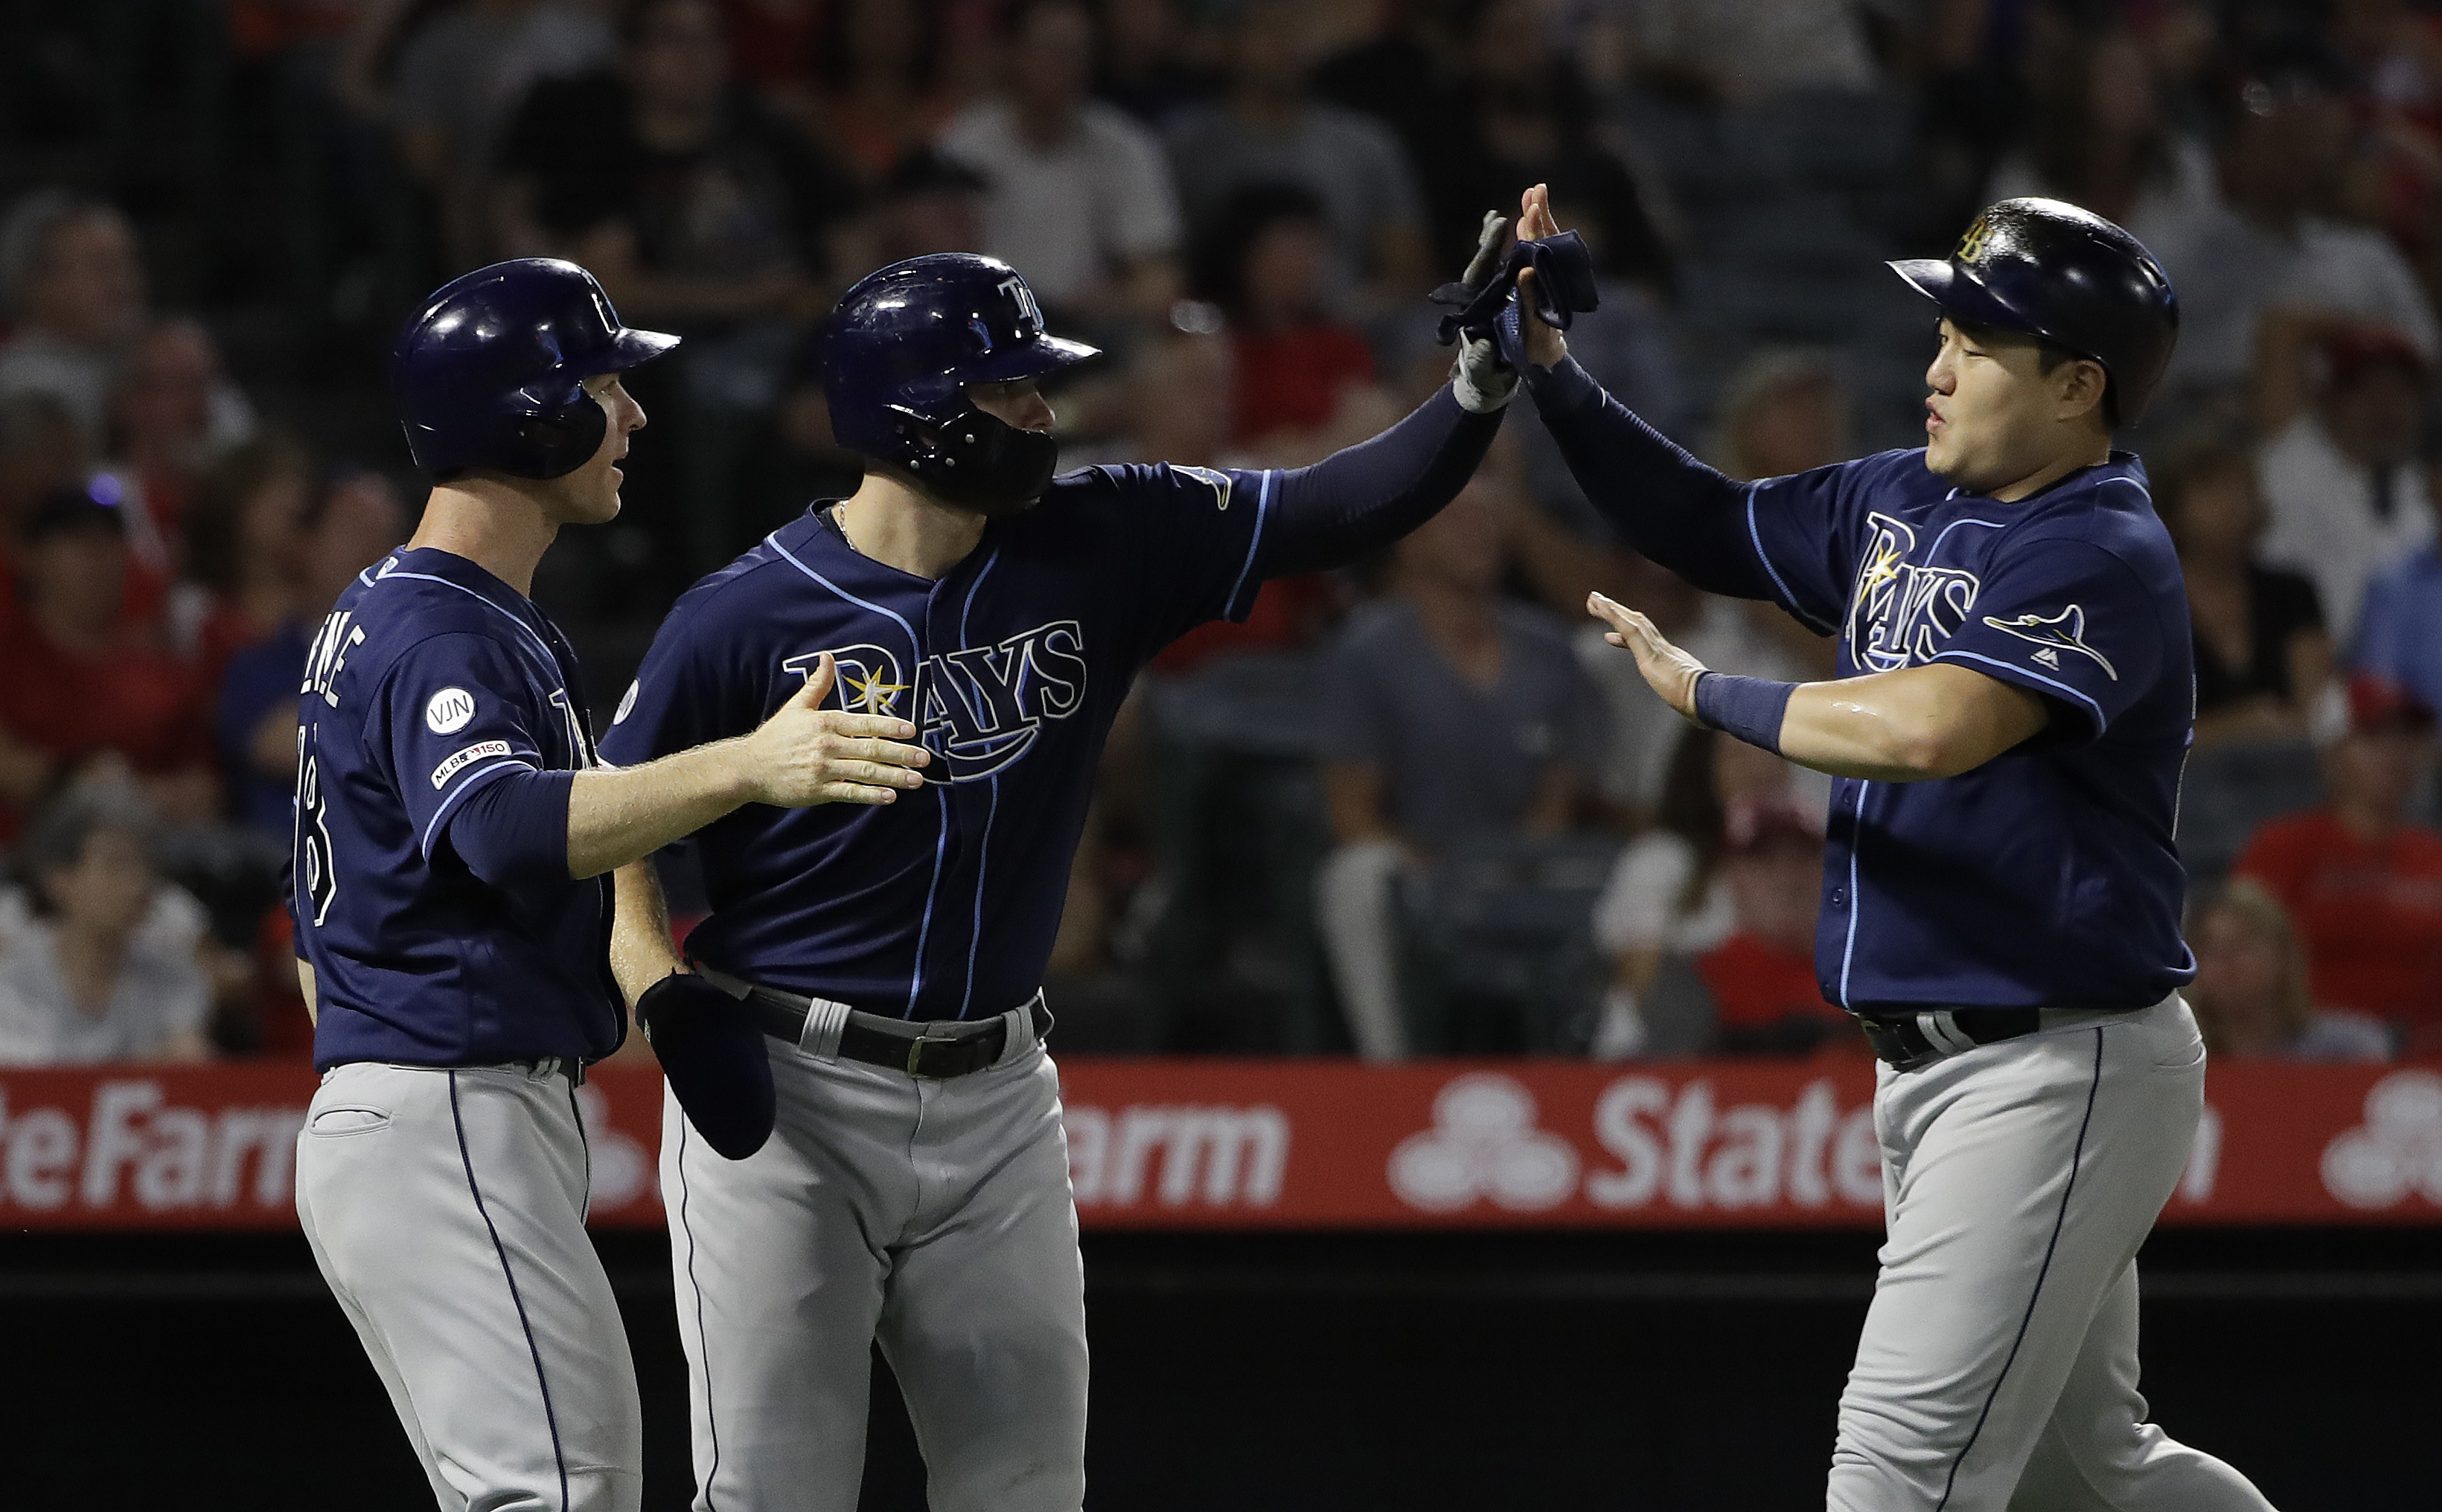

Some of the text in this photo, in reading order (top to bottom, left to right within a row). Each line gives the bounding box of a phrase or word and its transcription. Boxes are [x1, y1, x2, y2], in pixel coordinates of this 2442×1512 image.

[429, 694, 470, 725] VJN
[781, 620, 1087, 784] RAYS
[435, 743, 505, 784] MLB 150
